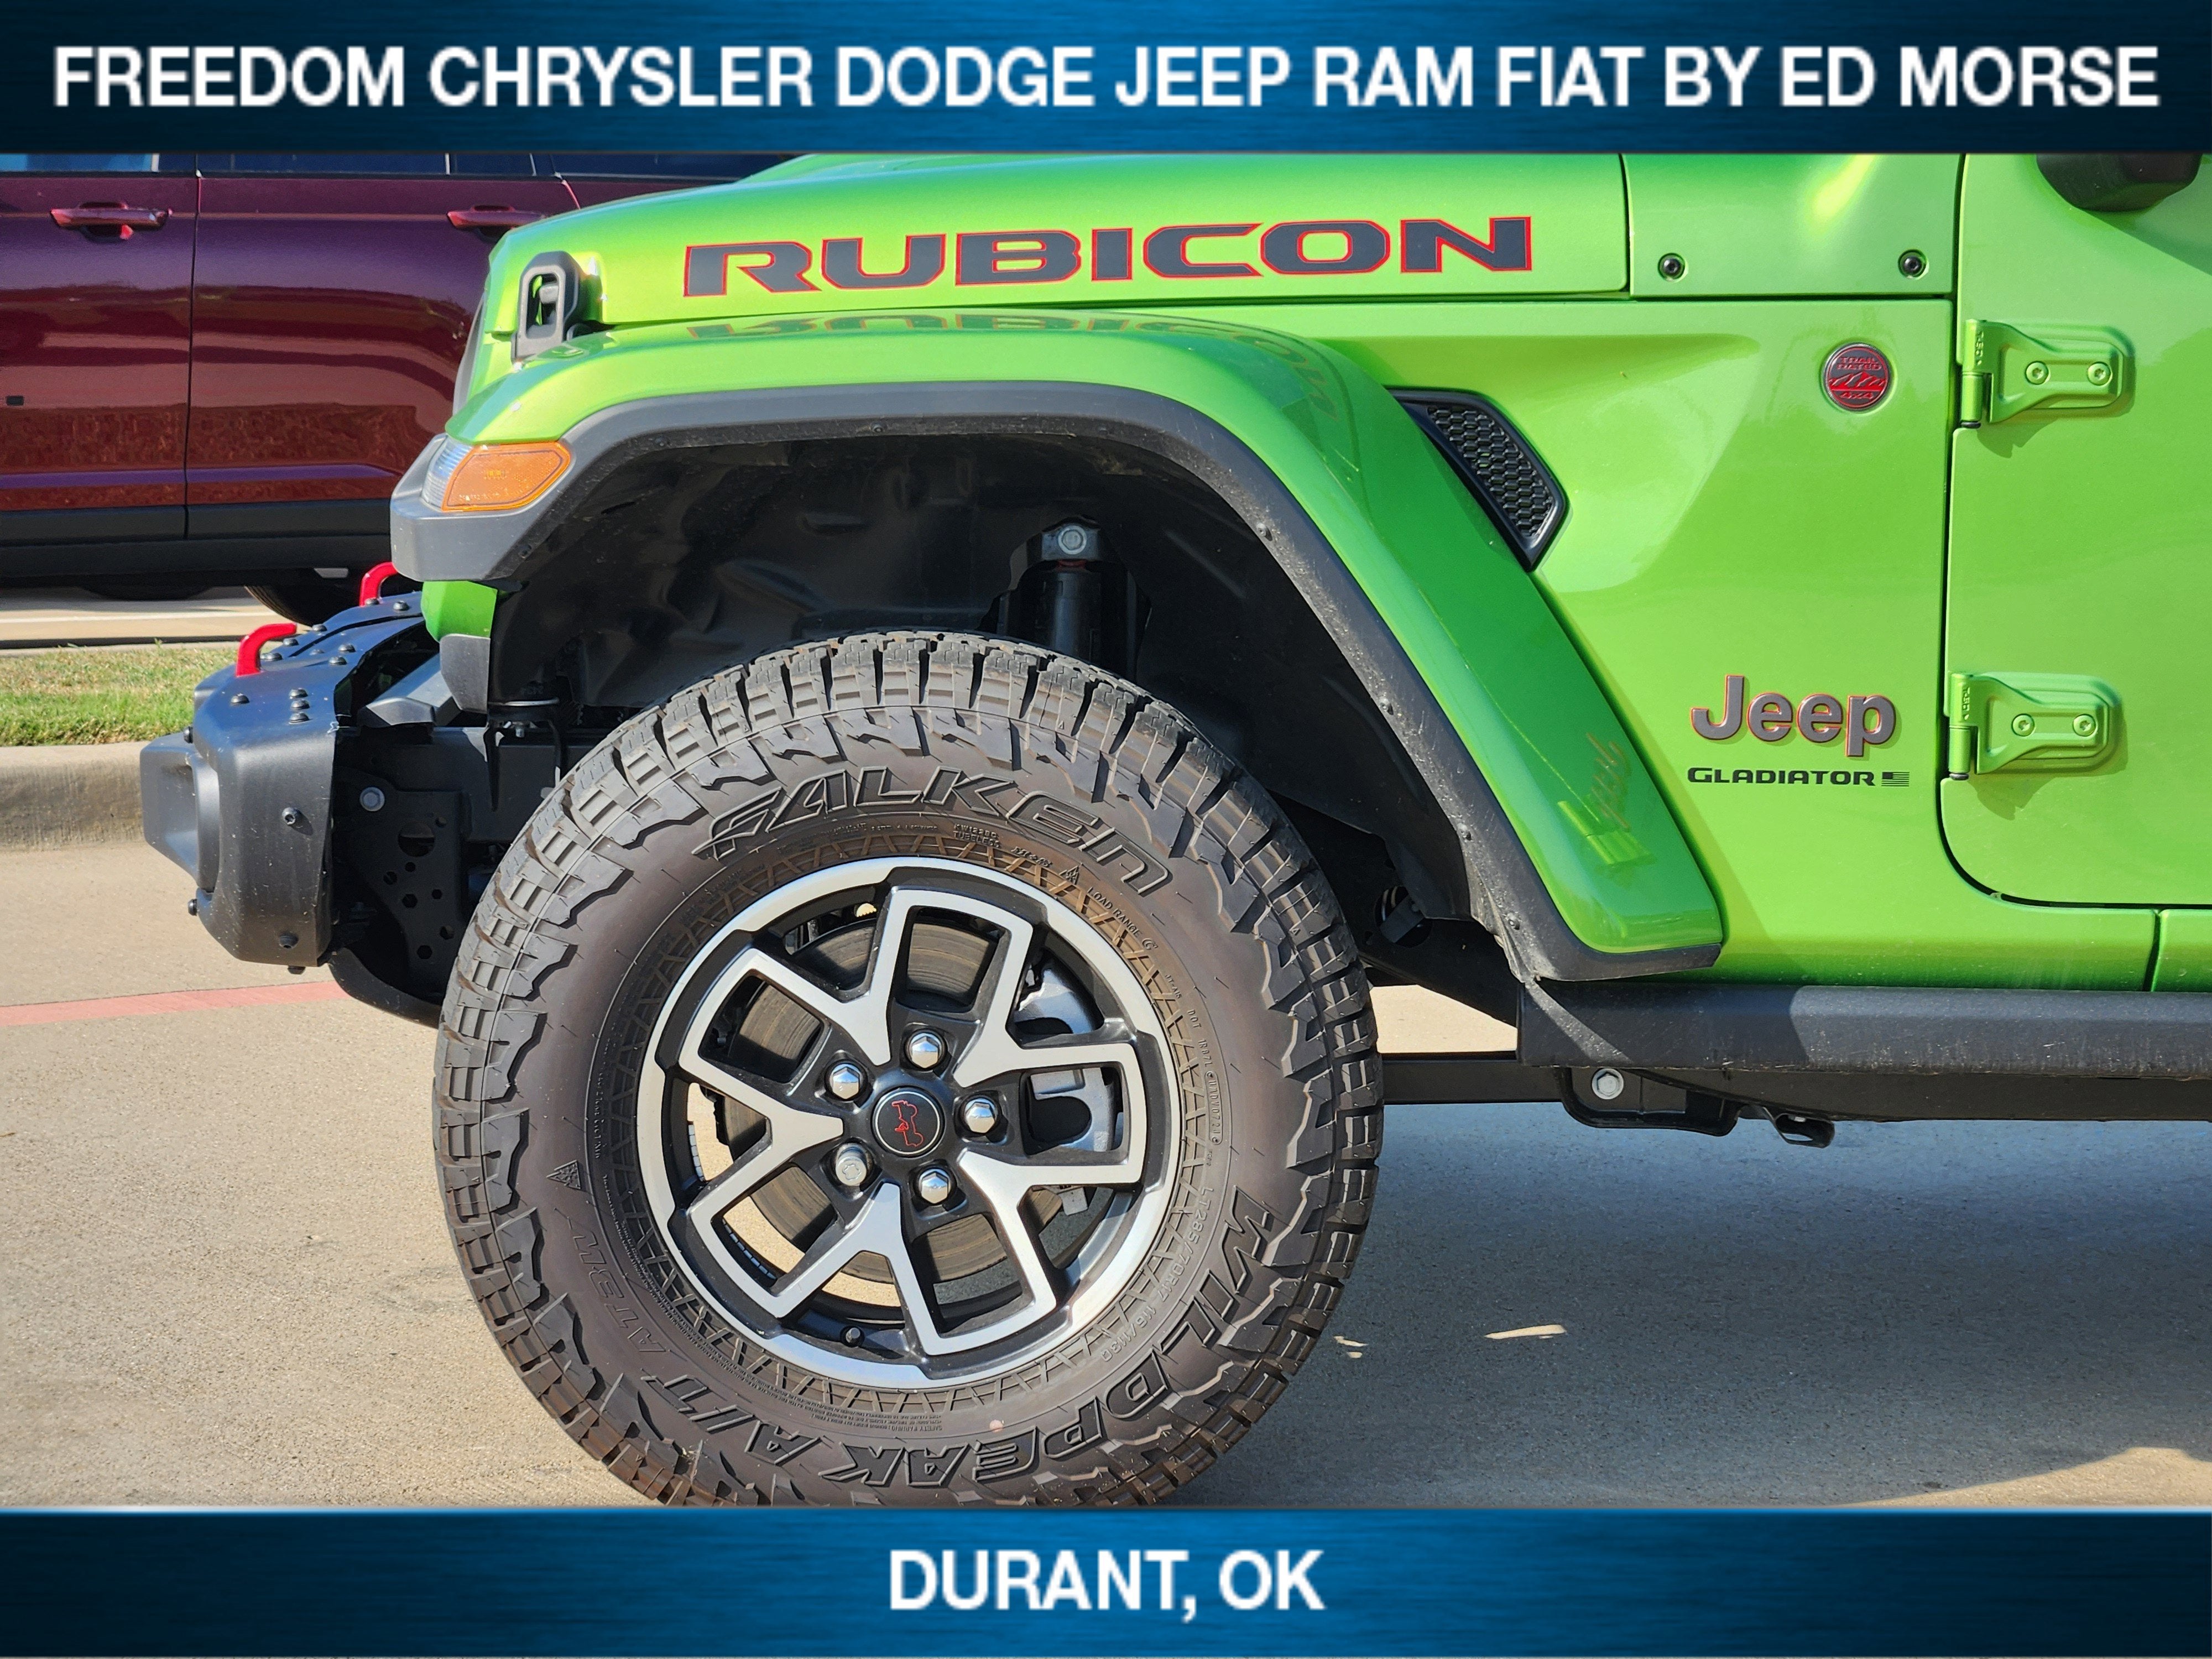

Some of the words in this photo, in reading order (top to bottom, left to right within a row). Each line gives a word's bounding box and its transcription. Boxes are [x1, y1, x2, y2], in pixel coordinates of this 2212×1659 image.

[684, 216, 1532, 297] RUBICON
[1691, 675, 1896, 757] Jeep
[1687, 766, 1876, 787] GLADIATOR
[952, 832, 1001, 848] TUBELESS
[1086, 886, 1113, 910] LOAD
[1113, 907, 1143, 937] RANGE
[1187, 1009, 1202, 1029] DOT
[1157, 1186, 1214, 1302] LT285/70R17
